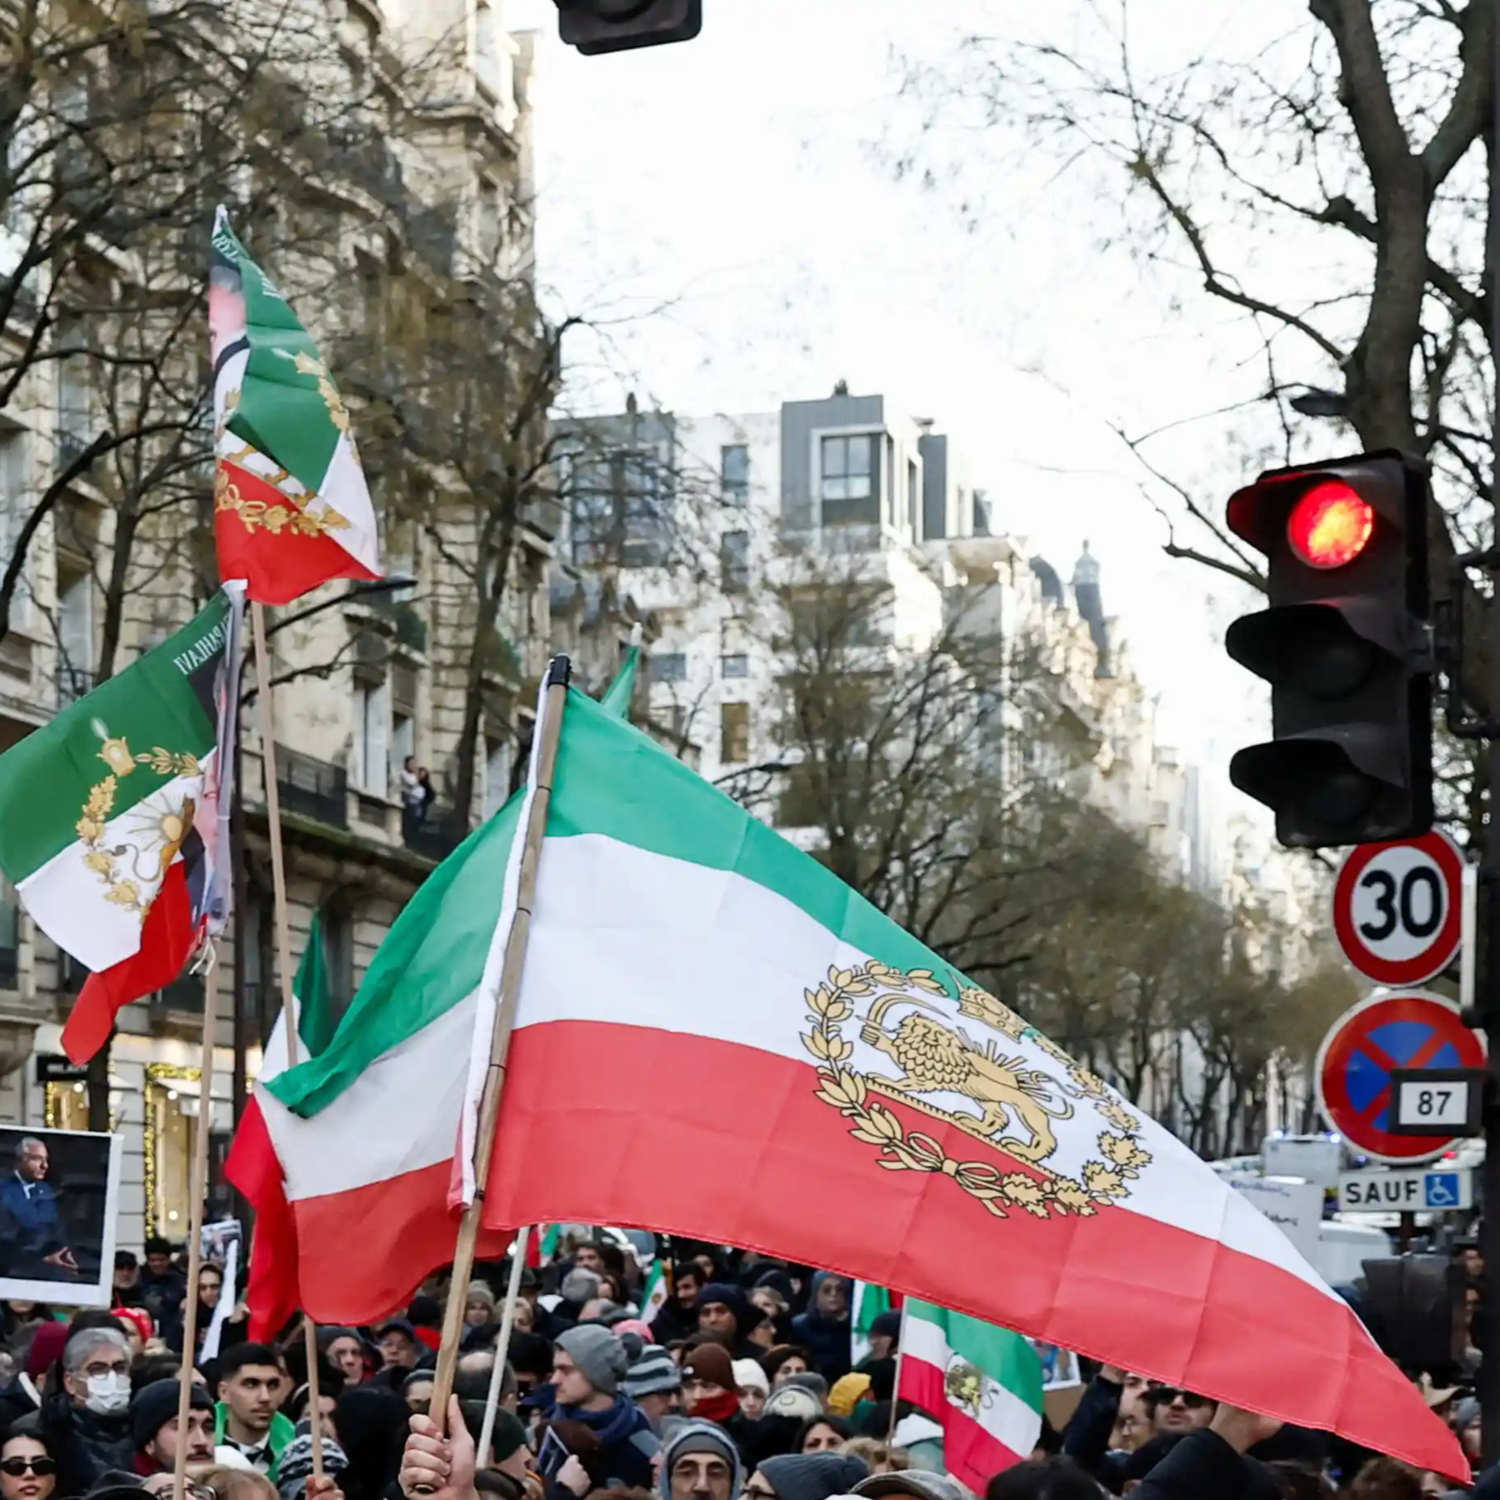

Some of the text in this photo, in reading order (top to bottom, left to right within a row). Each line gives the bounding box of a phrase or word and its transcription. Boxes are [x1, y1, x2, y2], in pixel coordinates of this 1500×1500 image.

[1360, 866, 1443, 941] 30
[1417, 1091, 1452, 1115] 87
[1345, 1179, 1419, 1204] SAUF
